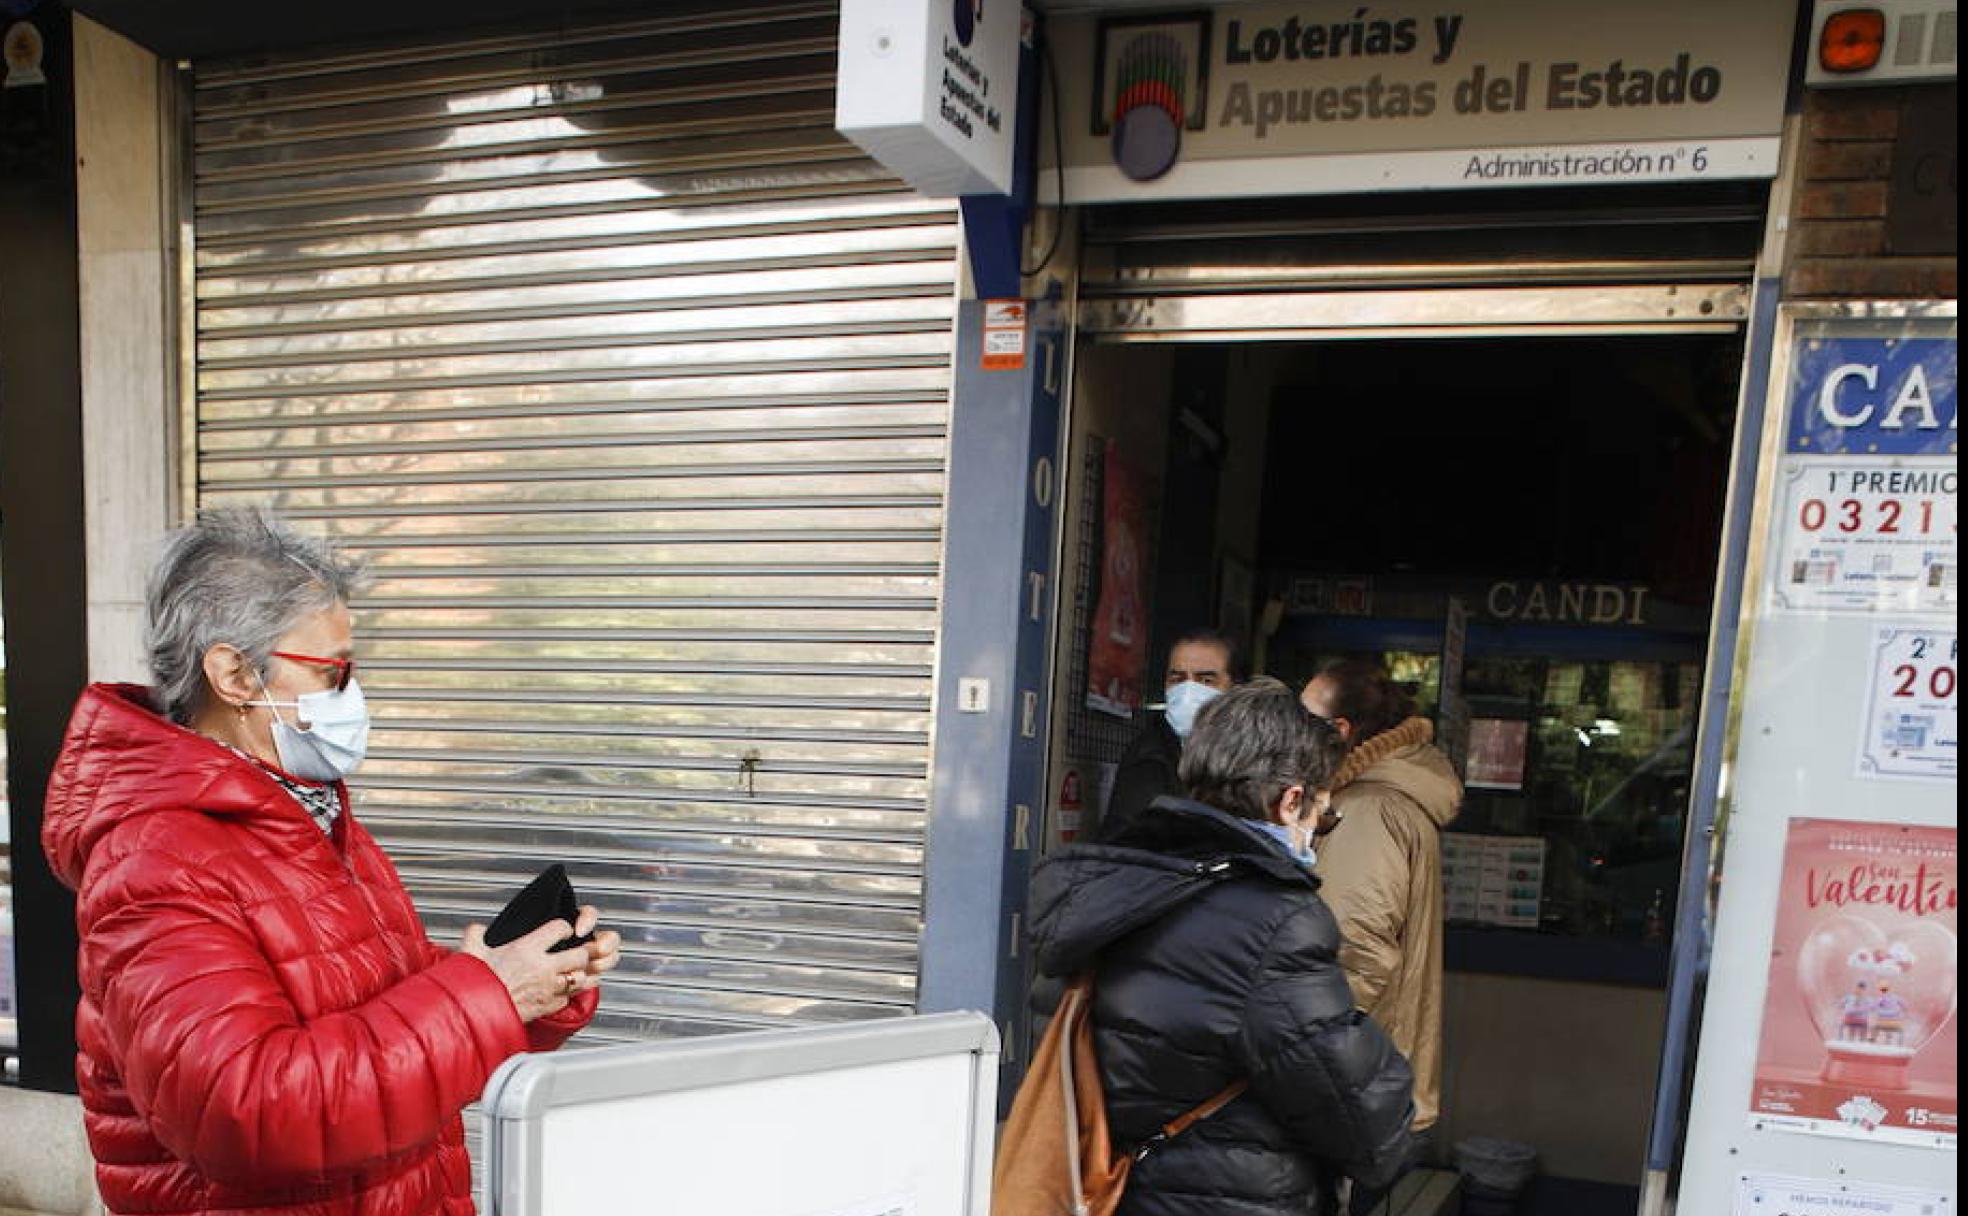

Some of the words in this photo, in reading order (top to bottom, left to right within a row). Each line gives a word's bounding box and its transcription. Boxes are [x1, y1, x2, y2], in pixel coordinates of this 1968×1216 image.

[1226, 7, 1417, 65] Loterías
[1432, 15, 1463, 65] y
[1219, 73, 1438, 138] Apuestas
[1453, 63, 1530, 116] del
[1546, 52, 1722, 112] Estado
[1464, 150, 1651, 179] Administración
[1691, 146, 1708, 172] 6
[1800, 499, 1957, 535] 0321
[1487, 581, 1649, 625] CANDI
[1893, 664, 1957, 699] 20
